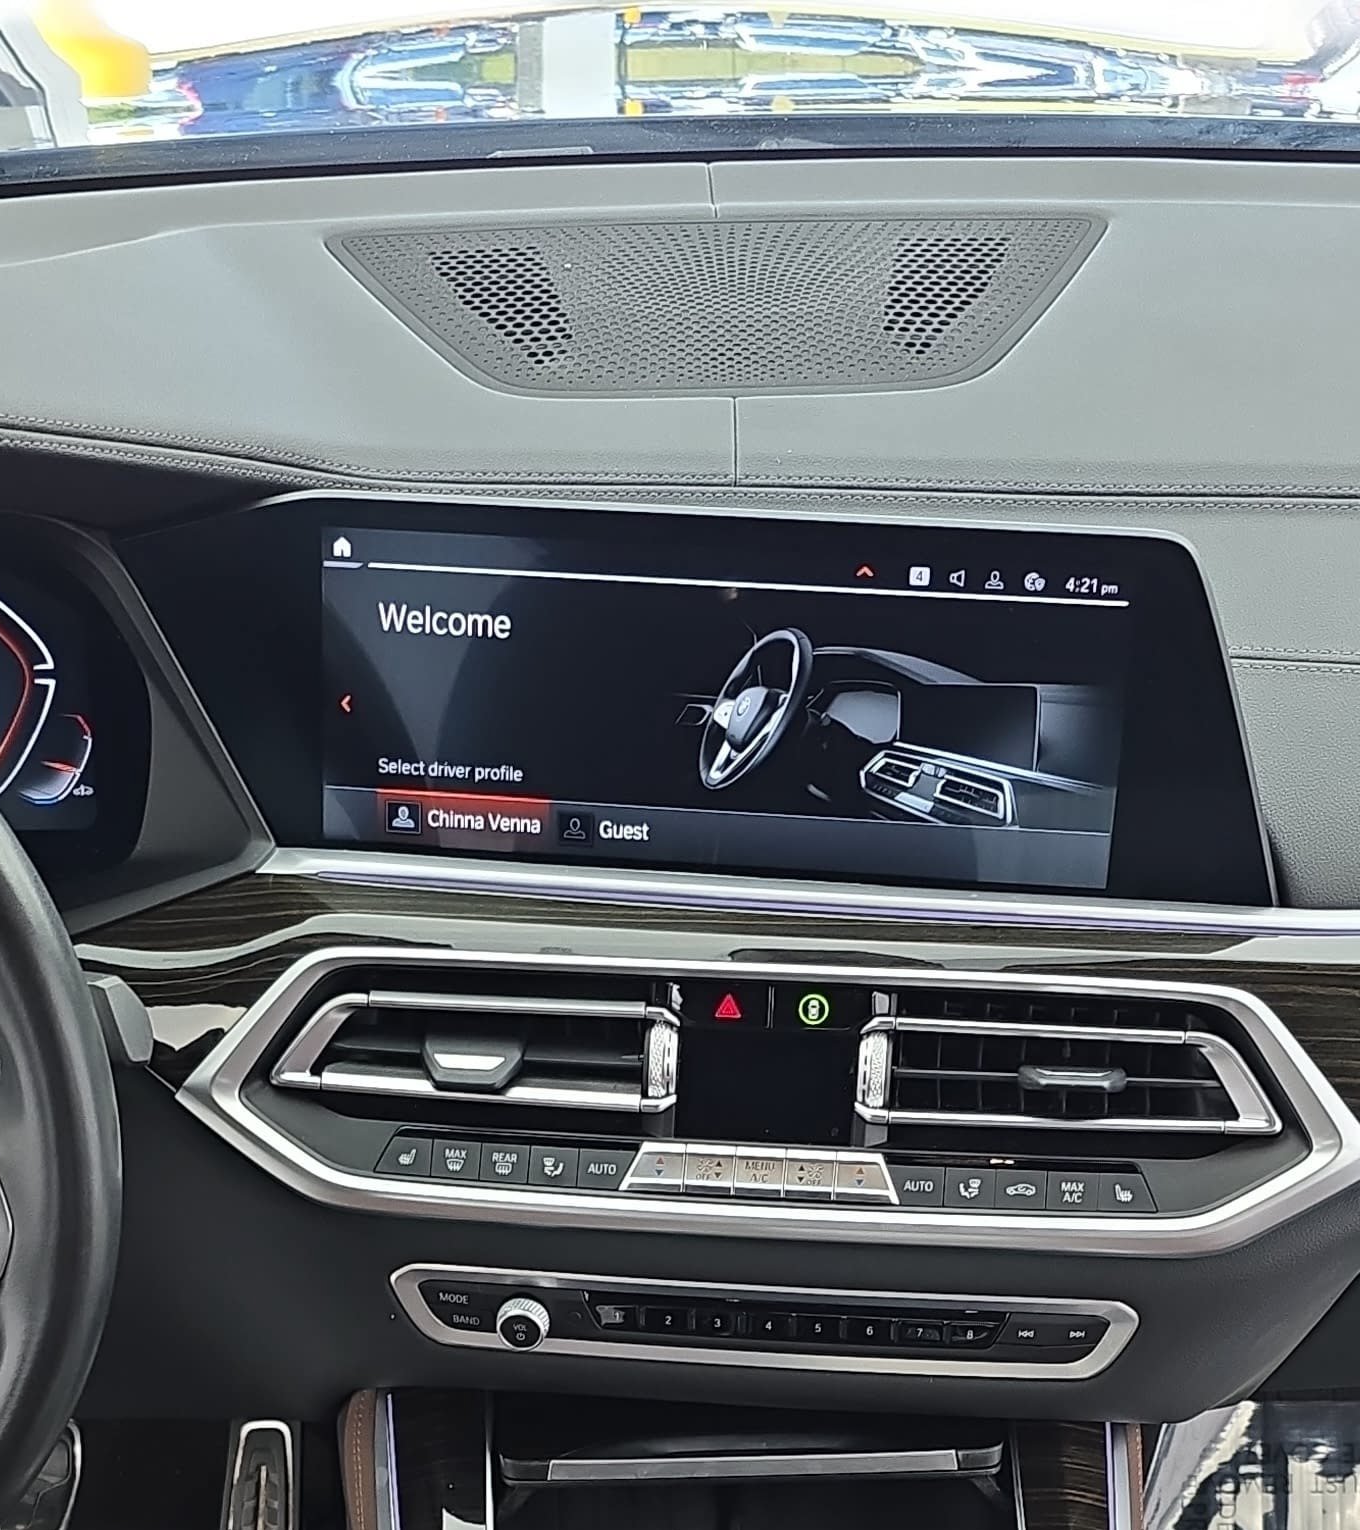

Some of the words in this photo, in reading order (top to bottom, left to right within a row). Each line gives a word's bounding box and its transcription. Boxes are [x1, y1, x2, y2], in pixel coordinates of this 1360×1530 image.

[1065, 577, 1098, 594] 4:21
[1100, 584, 1119, 596] pm
[378, 602, 512, 639] Welcome
[378, 757, 425, 776] Select
[428, 761, 471, 779] driver
[474, 764, 524, 783] profile
[427, 809, 484, 831] Chinna
[488, 812, 541, 835] Venna
[598, 820, 650, 842] Guest
[444, 1148, 467, 1160] MAX
[492, 1152, 517, 1164] REAR
[587, 1162, 617, 1175] AUTO
[744, 1160, 775, 1171] MENU
[903, 1179, 934, 1193] AUTO
[1061, 1181, 1085, 1192] MAX
[1061, 1191, 1083, 1204] A/C
[439, 1292, 470, 1305] MODE
[452, 1313, 481, 1327] BAND
[664, 1315, 673, 1326] 2
[713, 1317, 722, 1328] 3
[764, 1320, 773, 1331] 4
[814, 1322, 822, 1333] 5
[865, 1325, 874, 1336] 6
[916, 1327, 924, 1338] 7
[965, 1329, 975, 1340] 8
